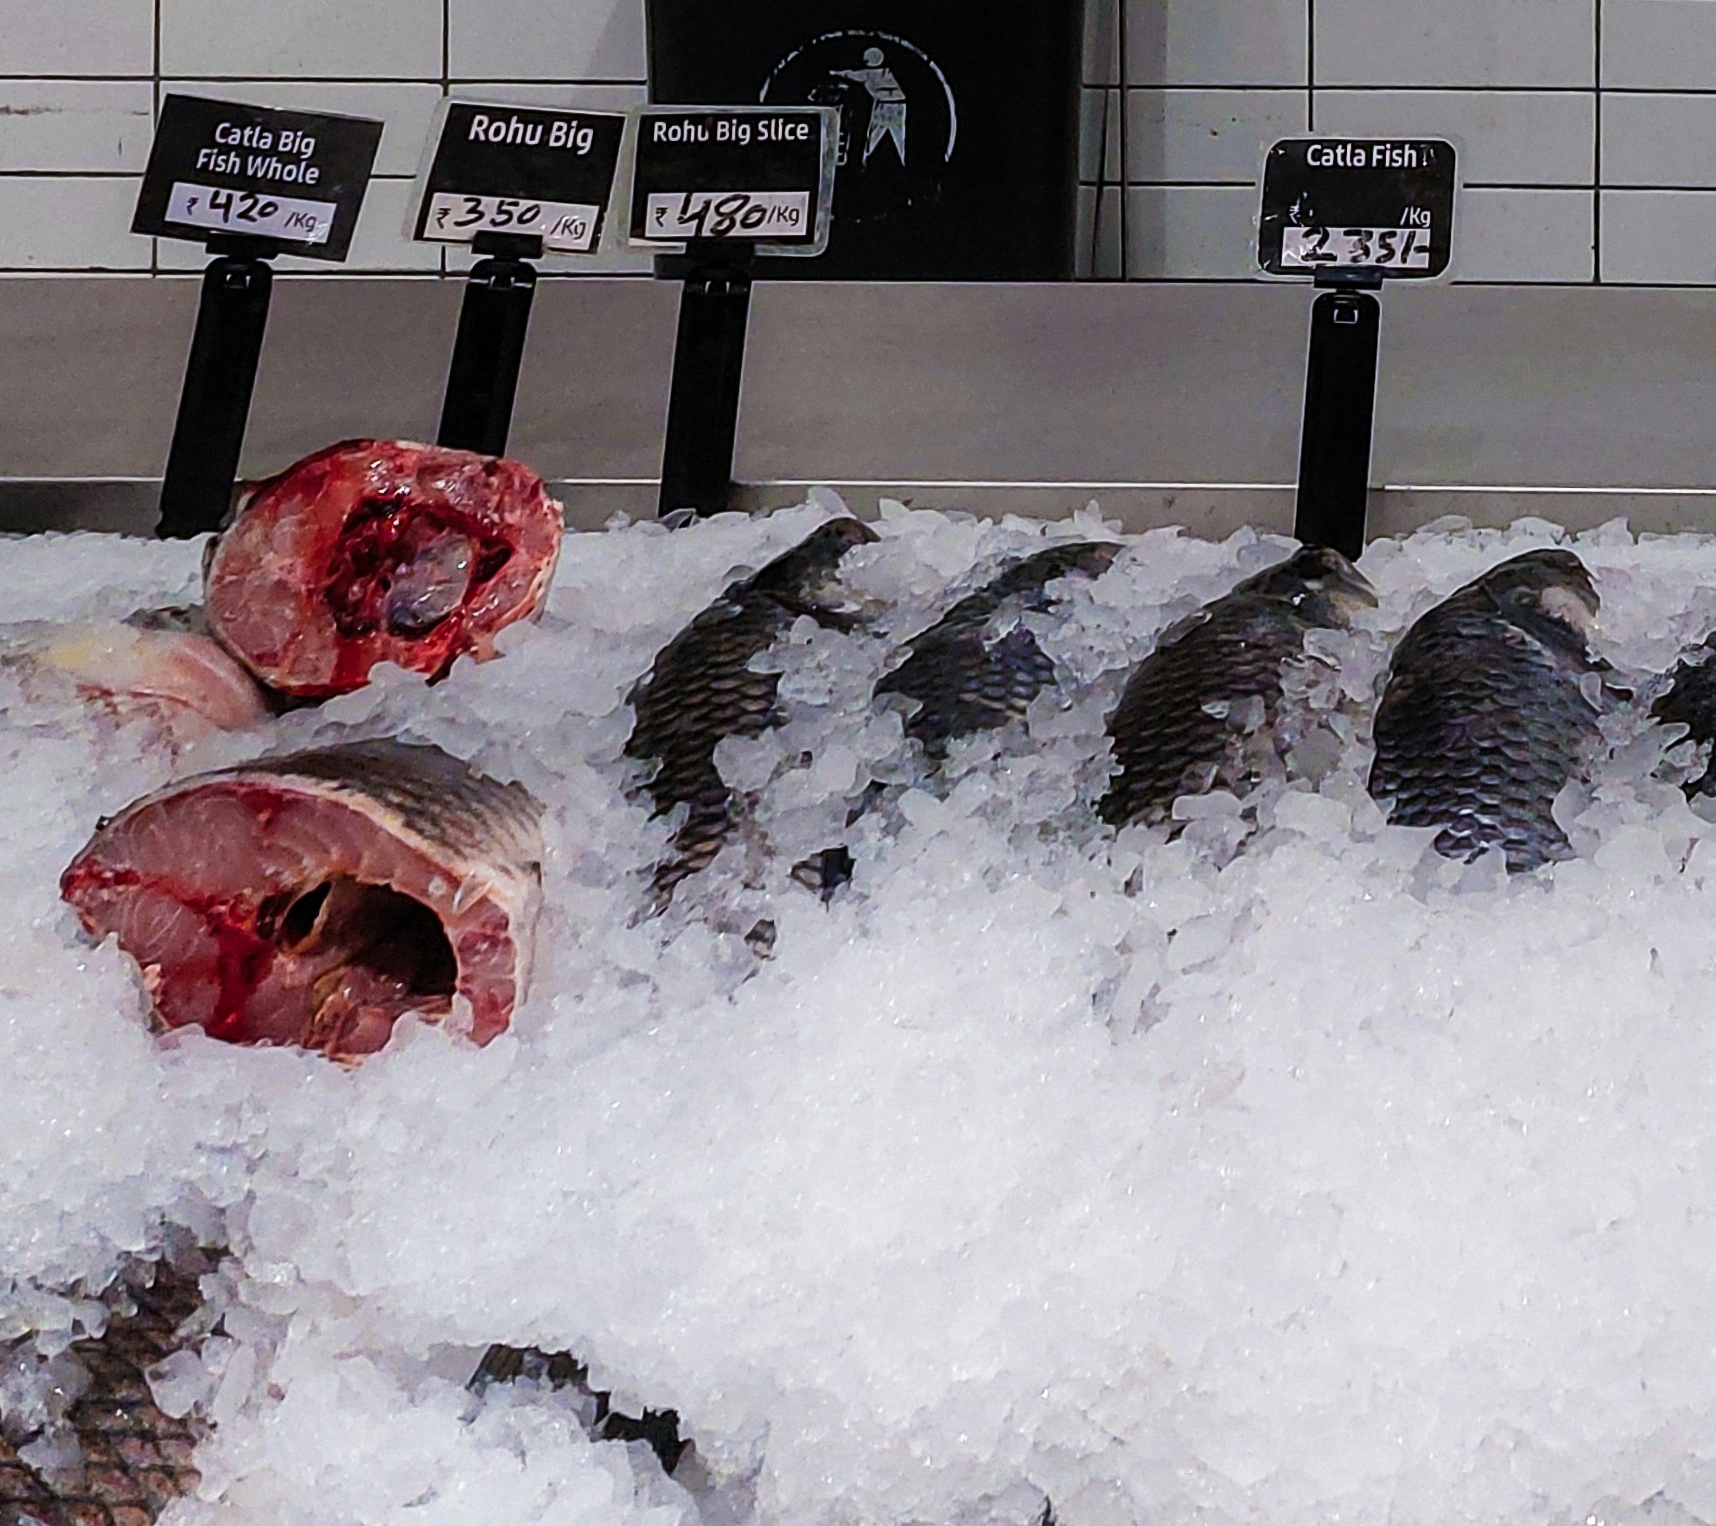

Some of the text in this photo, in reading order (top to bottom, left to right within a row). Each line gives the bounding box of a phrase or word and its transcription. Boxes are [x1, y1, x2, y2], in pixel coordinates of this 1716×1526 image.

[215, 122, 315, 158] Catla Big
[468, 114, 594, 155] Rohu Big
[653, 118, 809, 145] Rohu Big Slice
[196, 148, 319, 184] Fish Whole
[1306, 143, 1417, 167] Catla Fish
[209, 190, 279, 223] 420
[284, 211, 317, 232] /Kg
[453, 197, 541, 227] 350
[677, 192, 767, 236] 480
[1400, 206, 1431, 228] /Kg
